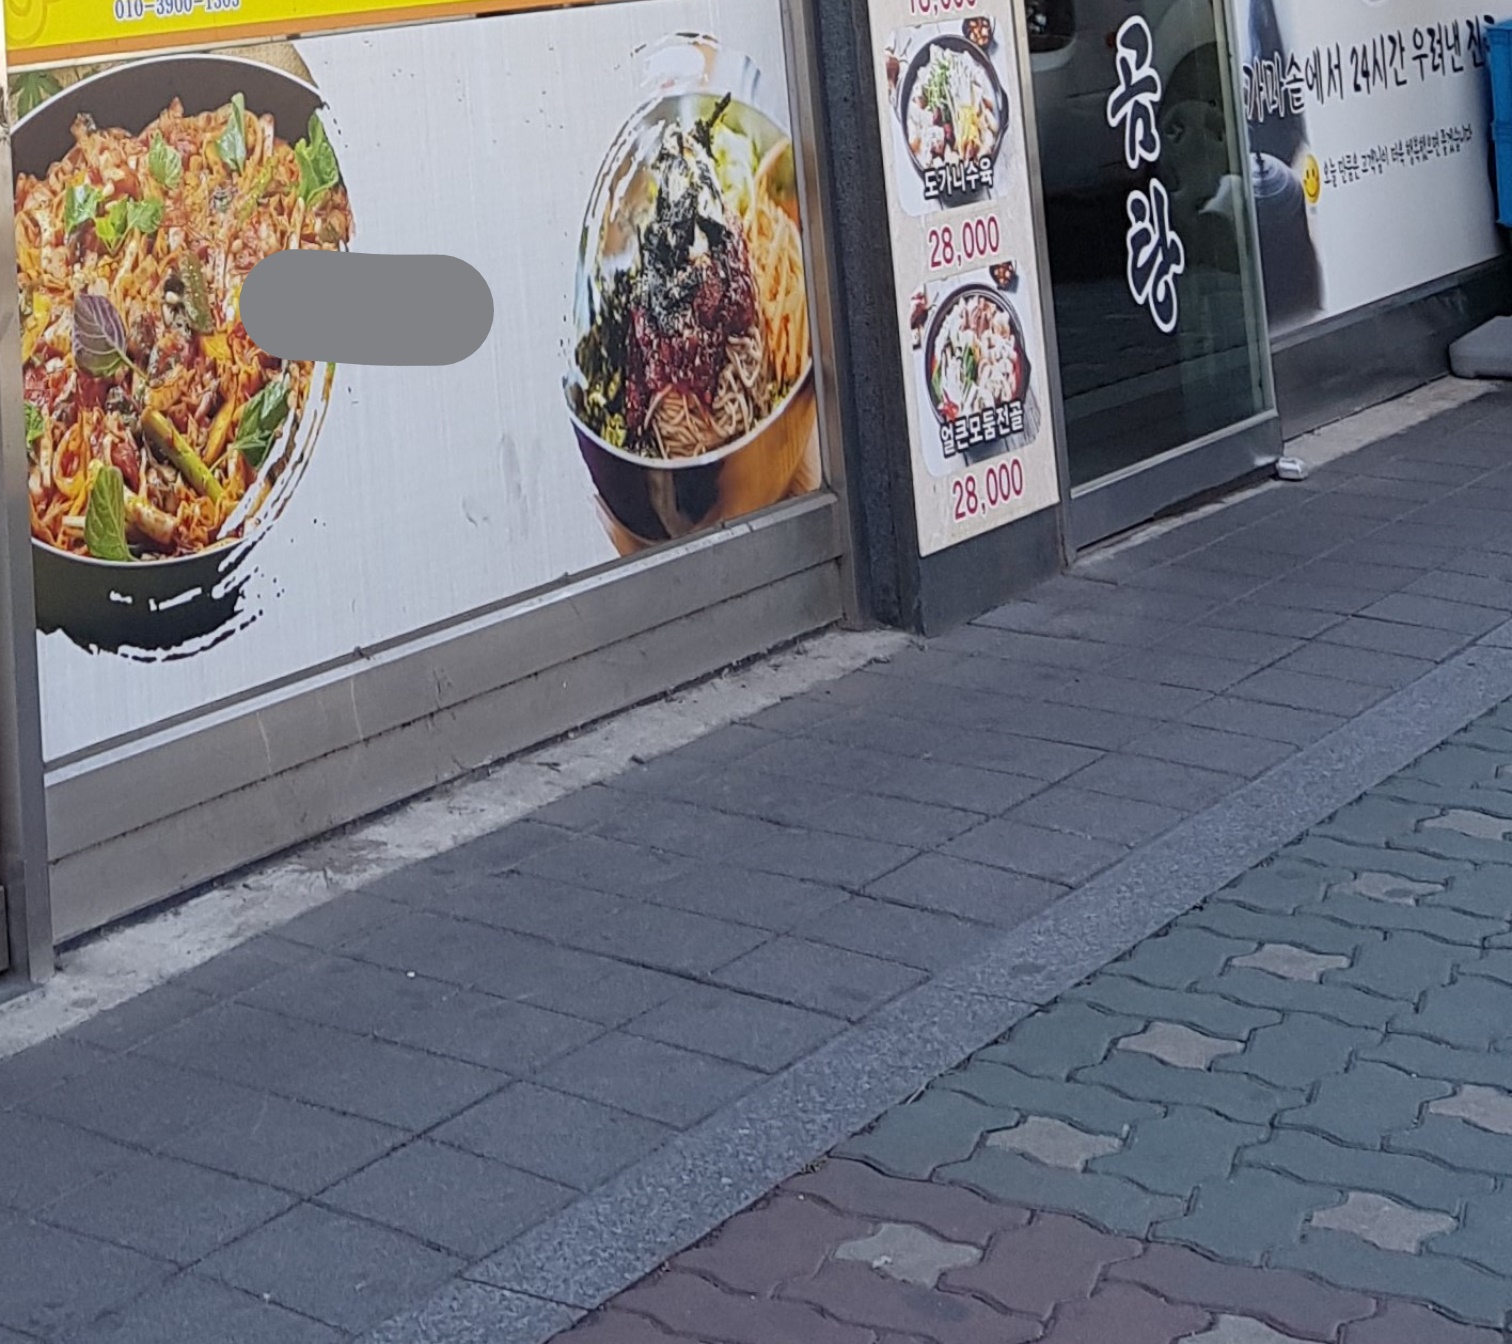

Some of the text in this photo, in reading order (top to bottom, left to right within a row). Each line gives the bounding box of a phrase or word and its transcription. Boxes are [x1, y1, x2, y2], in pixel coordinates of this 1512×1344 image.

[1243, 42, 1343, 123] 가마솥에서
[1351, 30, 1407, 95] 24시간
[1412, 22, 1463, 82] 우려낸
[924, 157, 994, 200] 도가니수육
[928, 215, 1000, 268] 28,000
[940, 400, 1024, 458] 얼큰모둠전골
[952, 458, 1024, 522] 28,000
